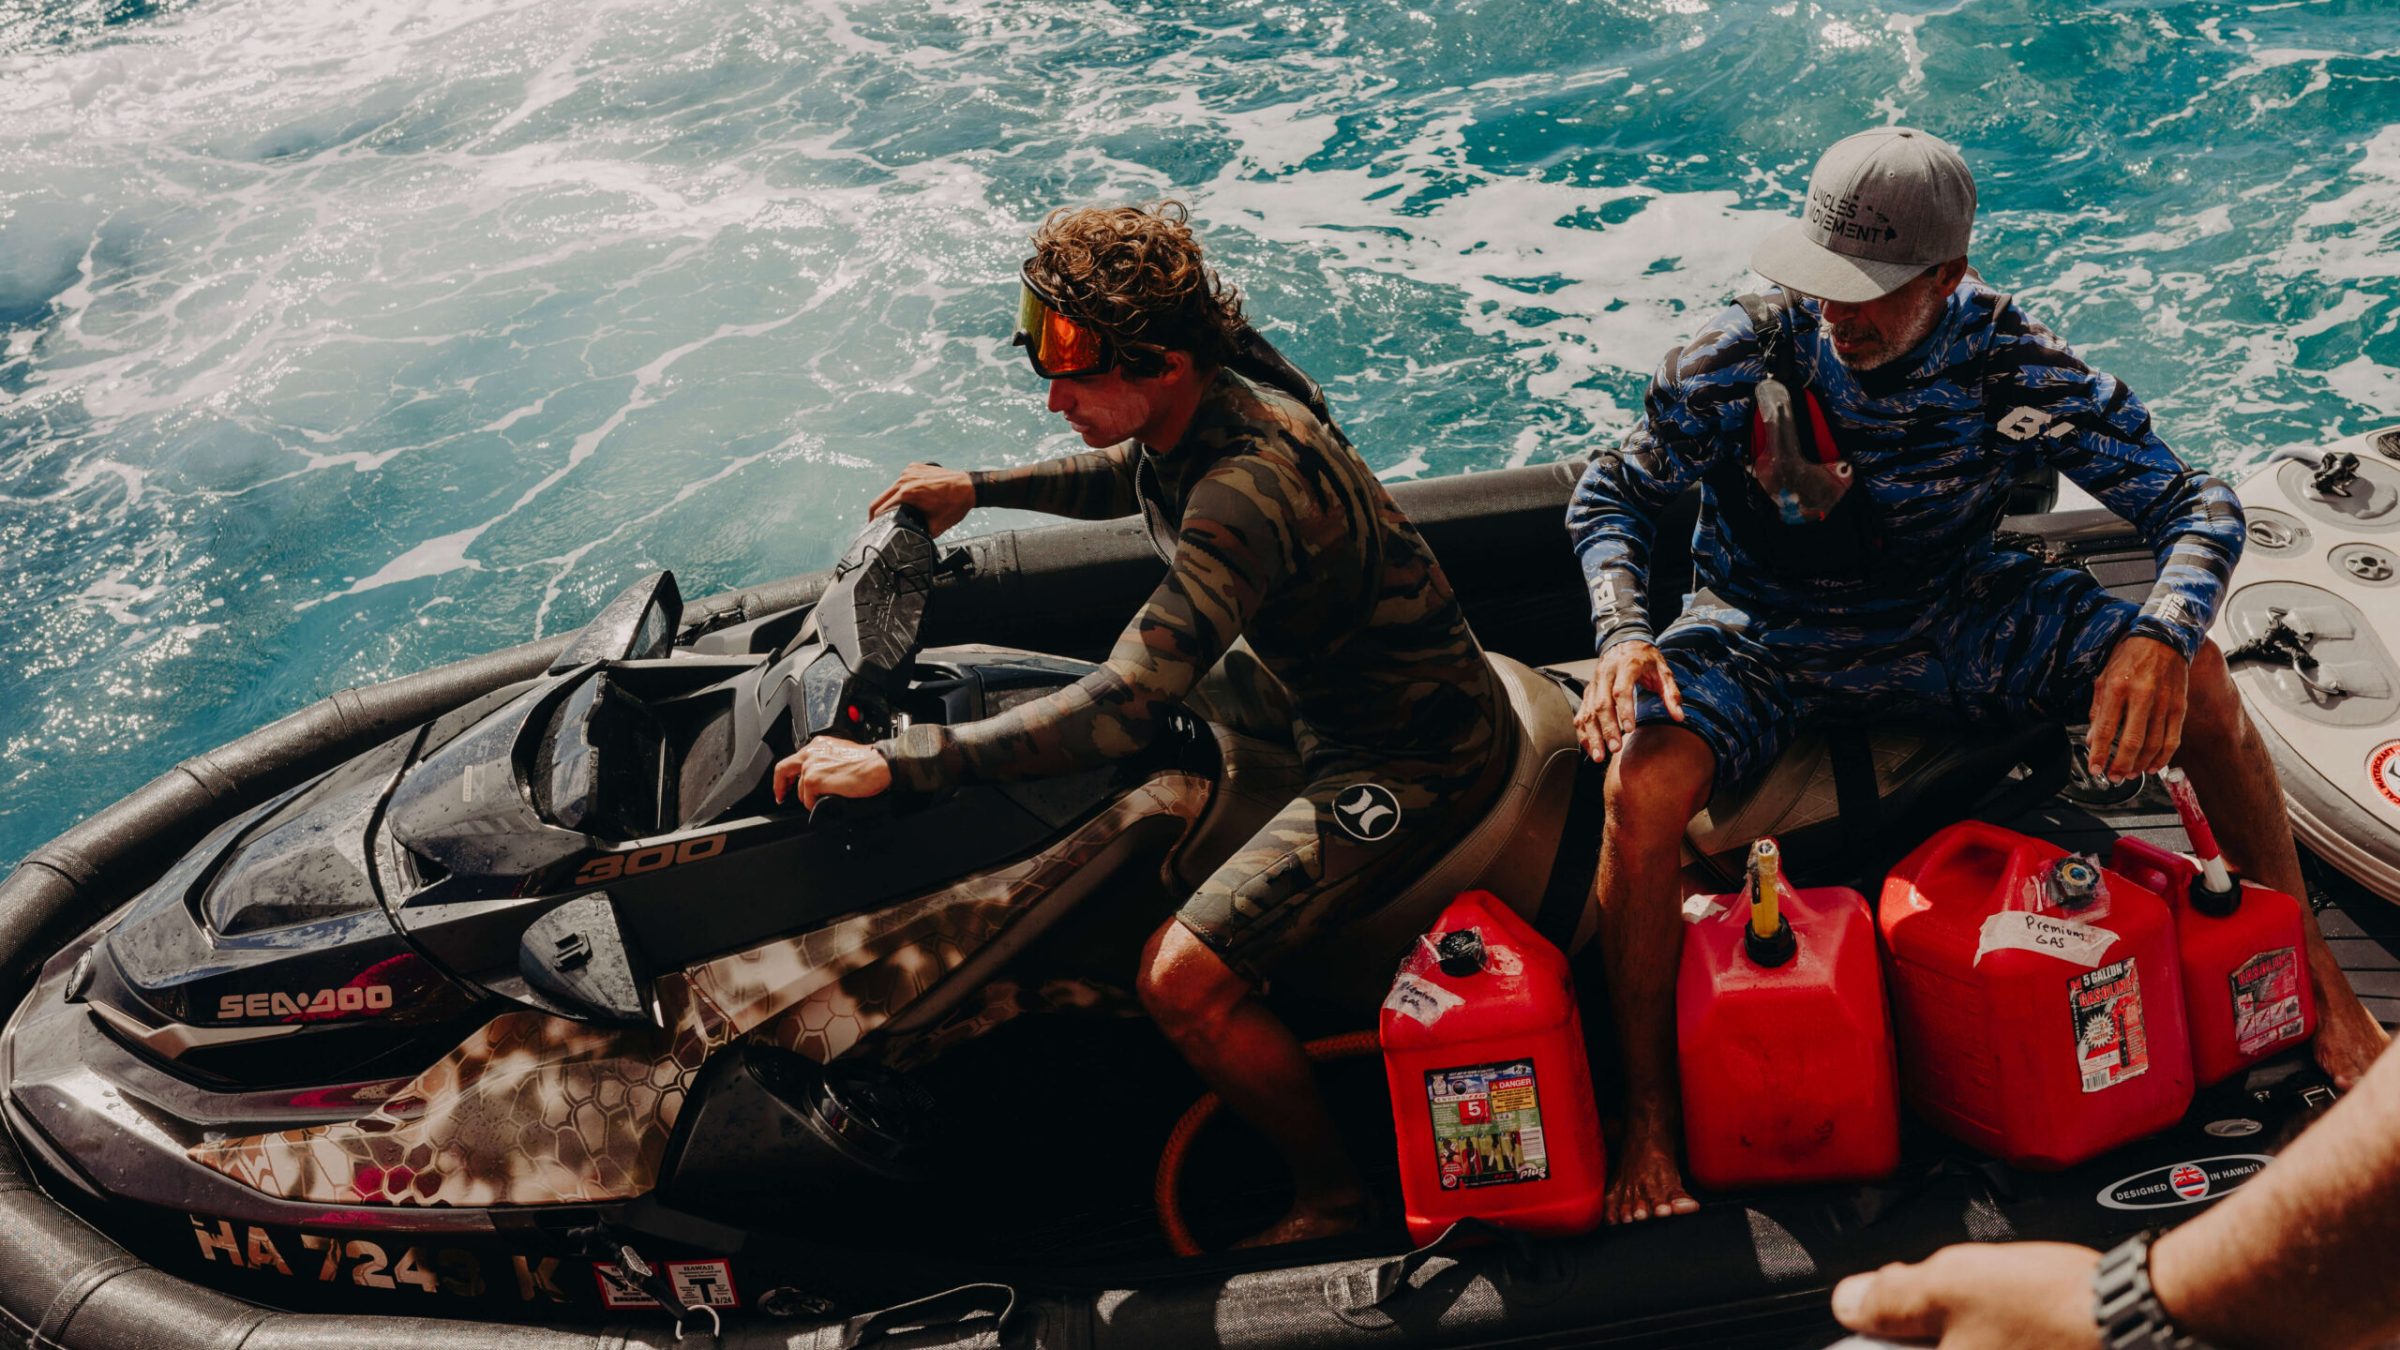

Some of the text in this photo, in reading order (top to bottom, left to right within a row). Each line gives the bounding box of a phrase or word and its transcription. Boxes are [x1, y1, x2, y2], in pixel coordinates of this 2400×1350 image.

[1813, 185, 1858, 219] UNCLES
[1808, 203, 1882, 243] MOVEMENT
[575, 833, 727, 885] 300
[2036, 934, 2064, 948] GAS
[2083, 962, 2123, 987] 5 GALLON
[1499, 1078, 1532, 1089] DANGER
[1468, 1101, 1480, 1116] 5
[2116, 1183, 2168, 1201] DESIGNED
[2209, 1172, 2221, 1182] IN
[189, 1213, 293, 1277] HA
